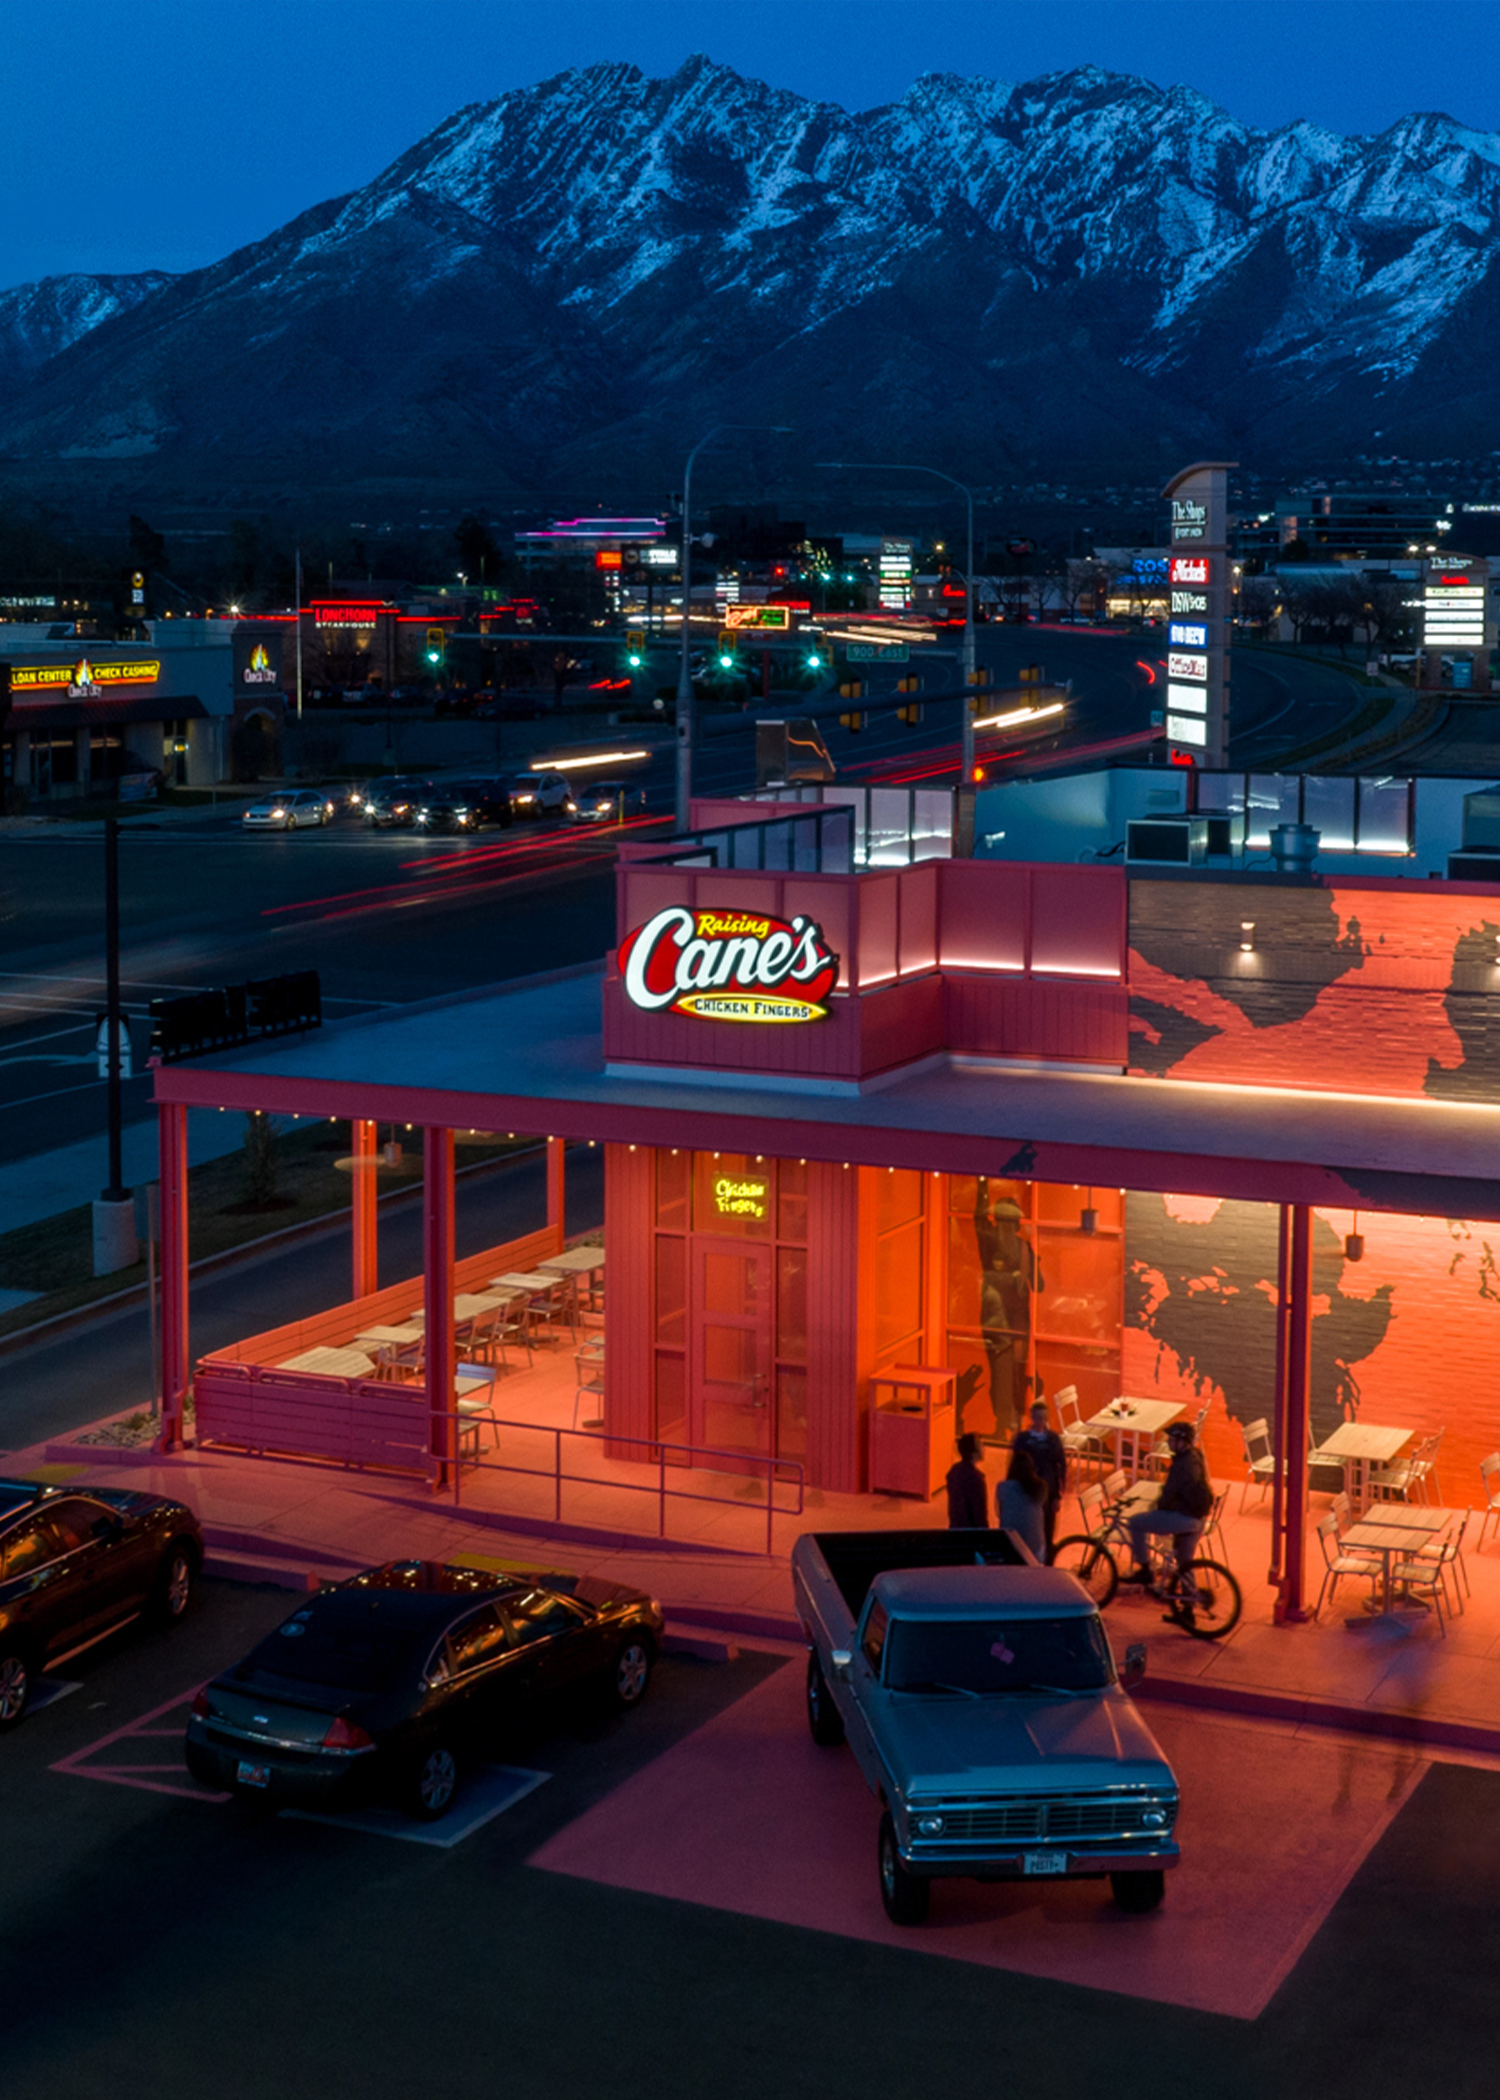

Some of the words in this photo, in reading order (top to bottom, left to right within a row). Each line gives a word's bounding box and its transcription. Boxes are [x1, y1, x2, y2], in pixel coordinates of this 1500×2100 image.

[1172, 501, 1185, 520] The
[1186, 500, 1206, 525] Shops
[1133, 559, 1171, 573] ROS
[1171, 591, 1192, 613] DSW
[315, 608, 377, 622] LONGHORN
[853, 646, 875, 658] 900
[12, 671, 37, 685] LOAN
[38, 669, 73, 683] CENTER
[94, 667, 122, 679] CHECK
[122, 665, 157, 678] CASHING
[697, 914, 770, 939] Raising
[625, 907, 832, 1009] Cane's
[694, 998, 749, 1014] CHICKEN
[753, 1001, 809, 1018] FINGERS
[716, 1180, 764, 1197] Chicken
[715, 1197, 763, 1217] Fingers
